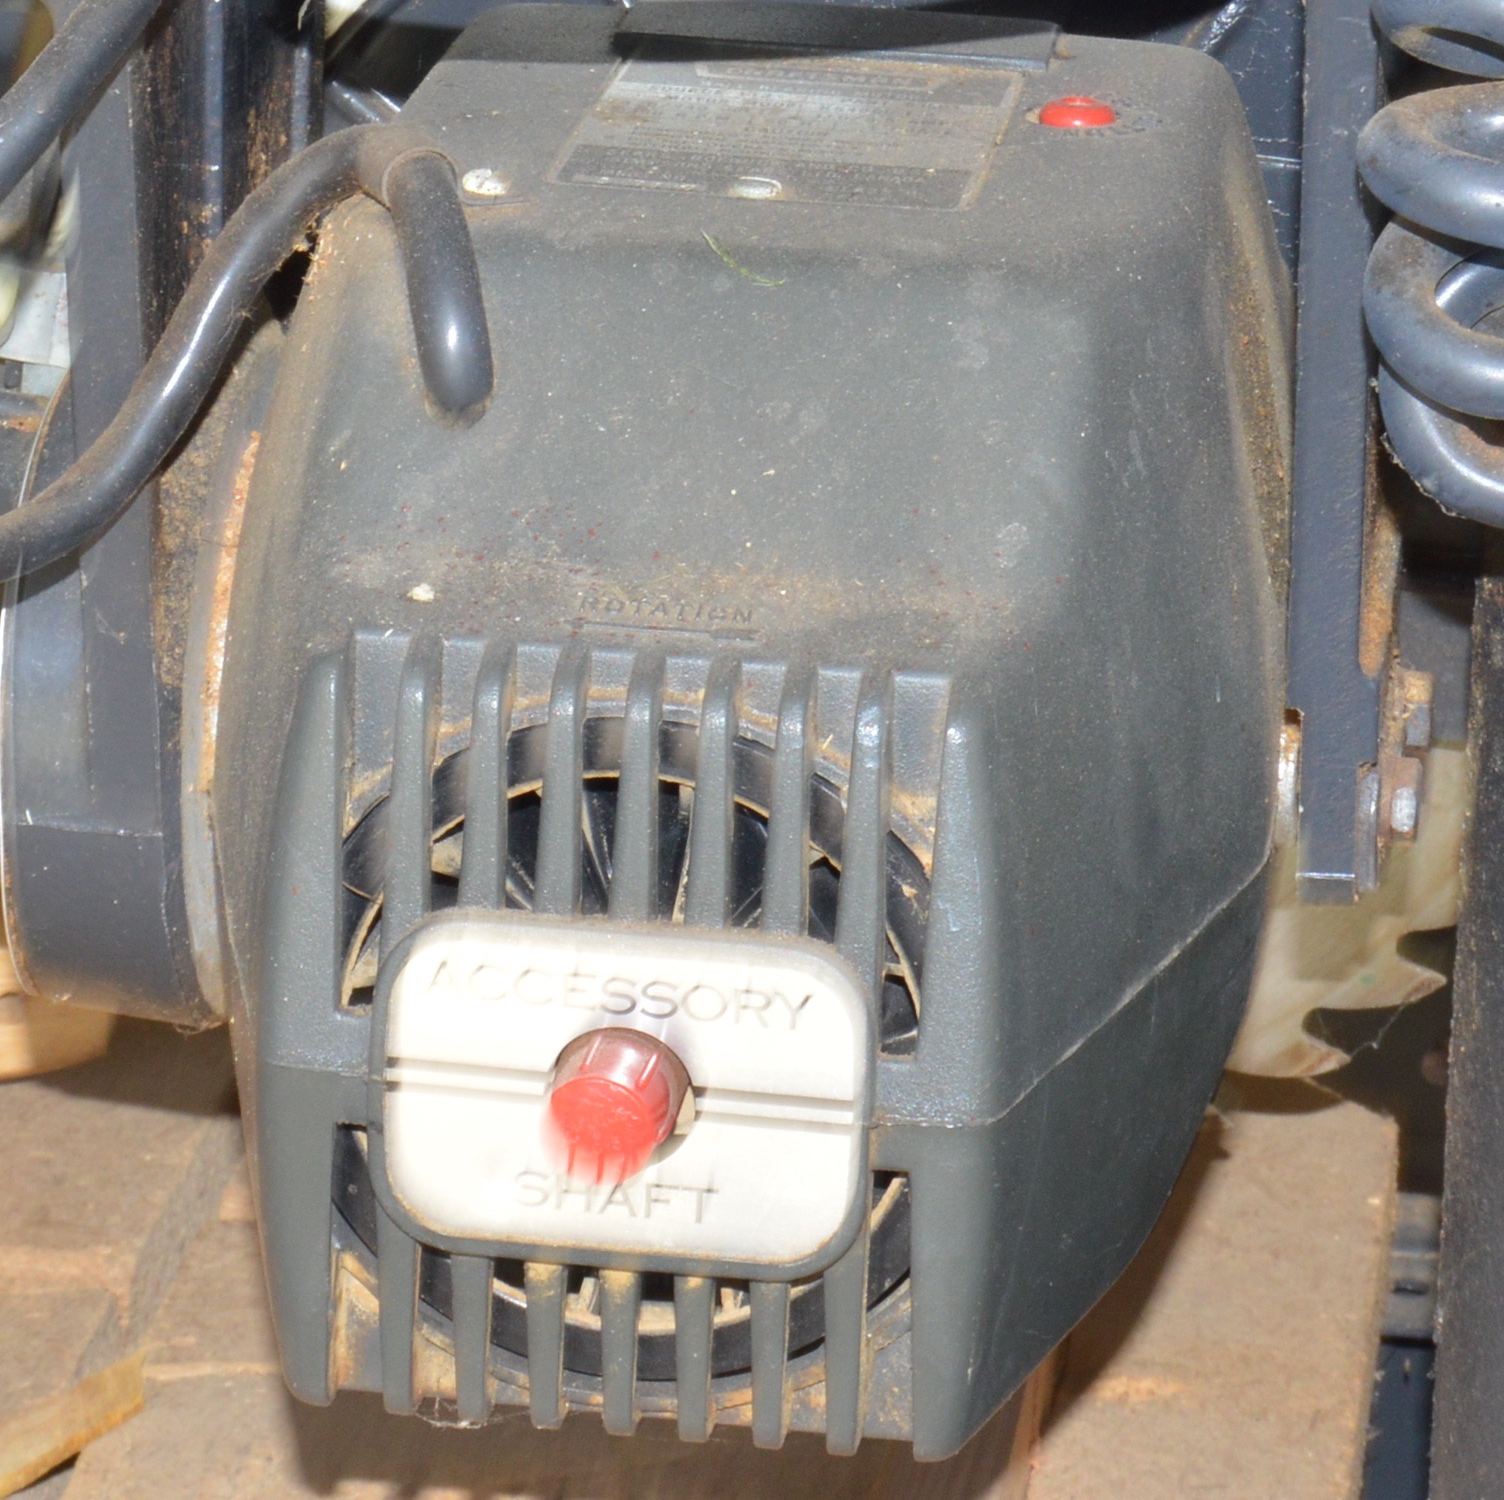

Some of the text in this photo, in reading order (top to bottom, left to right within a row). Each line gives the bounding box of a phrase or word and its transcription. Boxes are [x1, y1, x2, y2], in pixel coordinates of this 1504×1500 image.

[579, 595, 753, 624] ROTATION
[427, 960, 814, 1031] ACCESSORY
[513, 1168, 720, 1225] SHAFT
